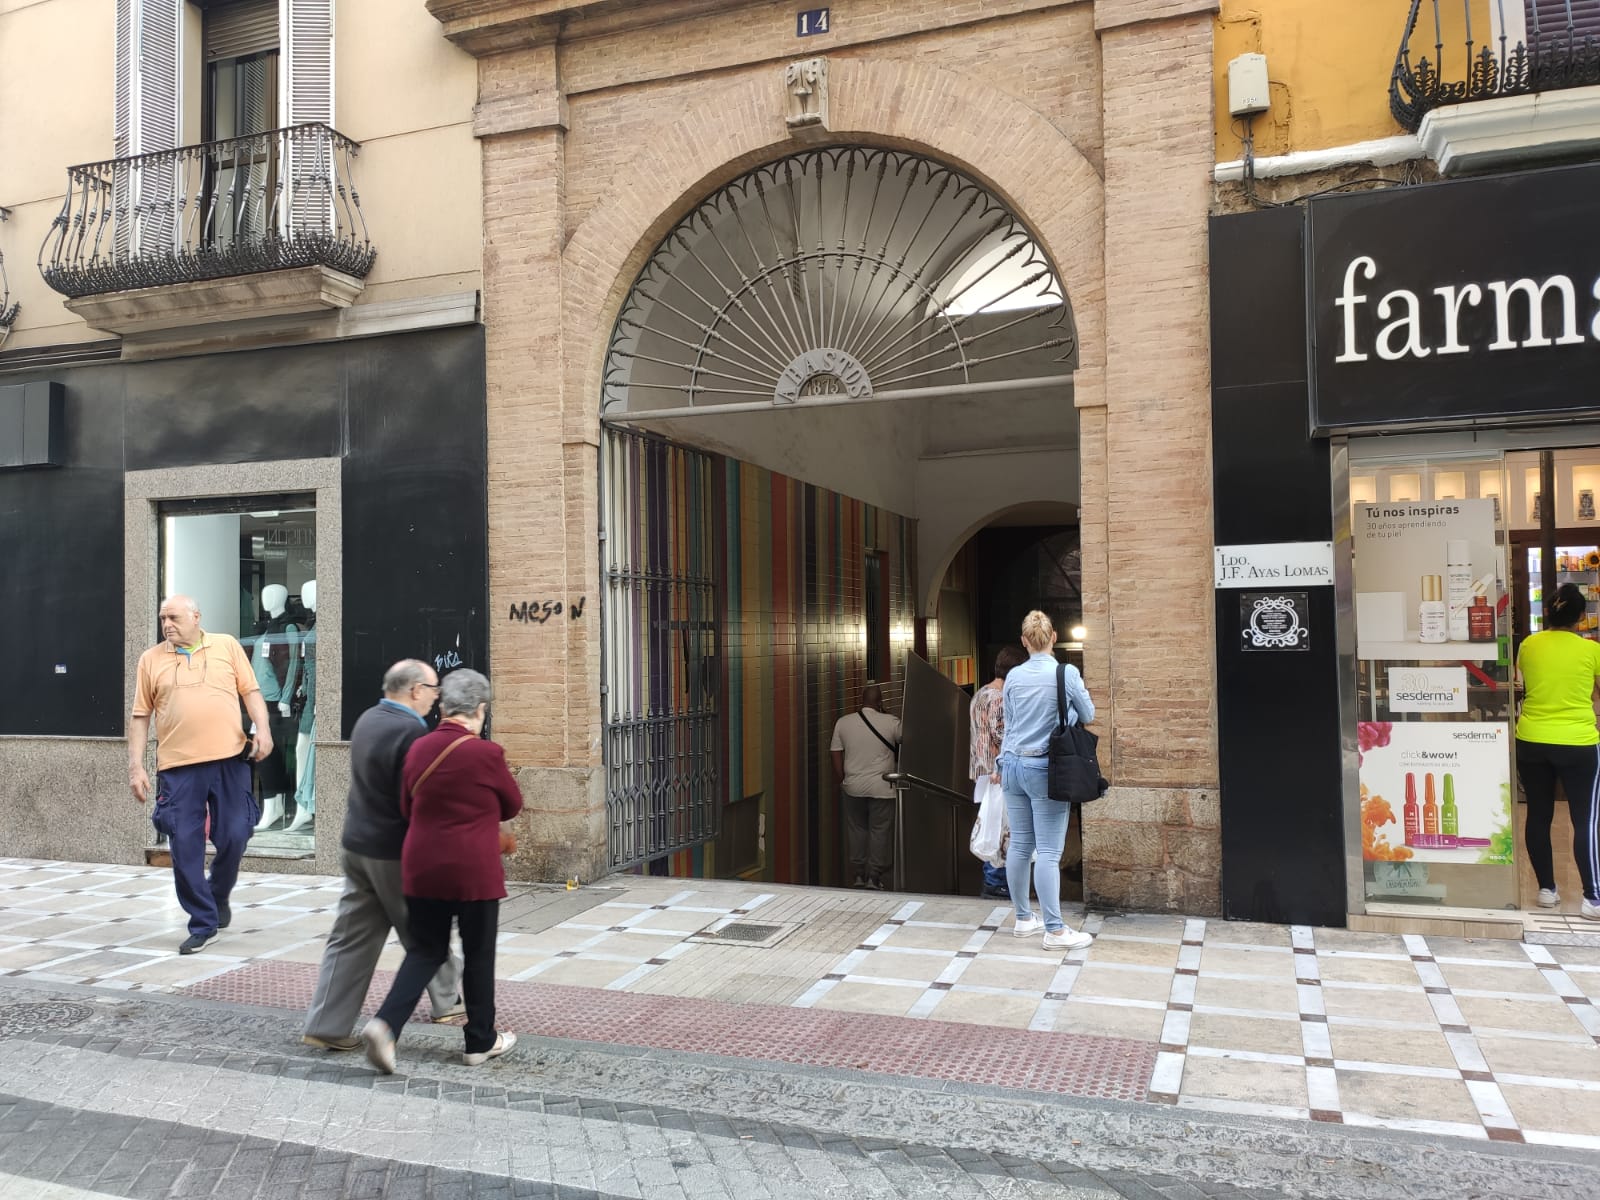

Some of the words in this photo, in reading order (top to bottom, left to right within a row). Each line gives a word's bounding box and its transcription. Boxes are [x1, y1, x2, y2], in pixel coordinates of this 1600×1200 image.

[801, 10, 827, 34] 14
[1335, 255, 1600, 363] farm
[1366, 507, 1380, 518] Tú
[1383, 508, 1405, 518] nos
[1408, 504, 1460, 518] inspiras
[1366, 522, 1377, 530] 30
[1378, 522, 1396, 530] años
[1398, 520, 1447, 531] aprendiendo
[1366, 531, 1376, 539] de
[1387, 529, 1402, 540] piel
[1396, 690, 1454, 701] sesderma
[1452, 730, 1497, 740] sesderma
